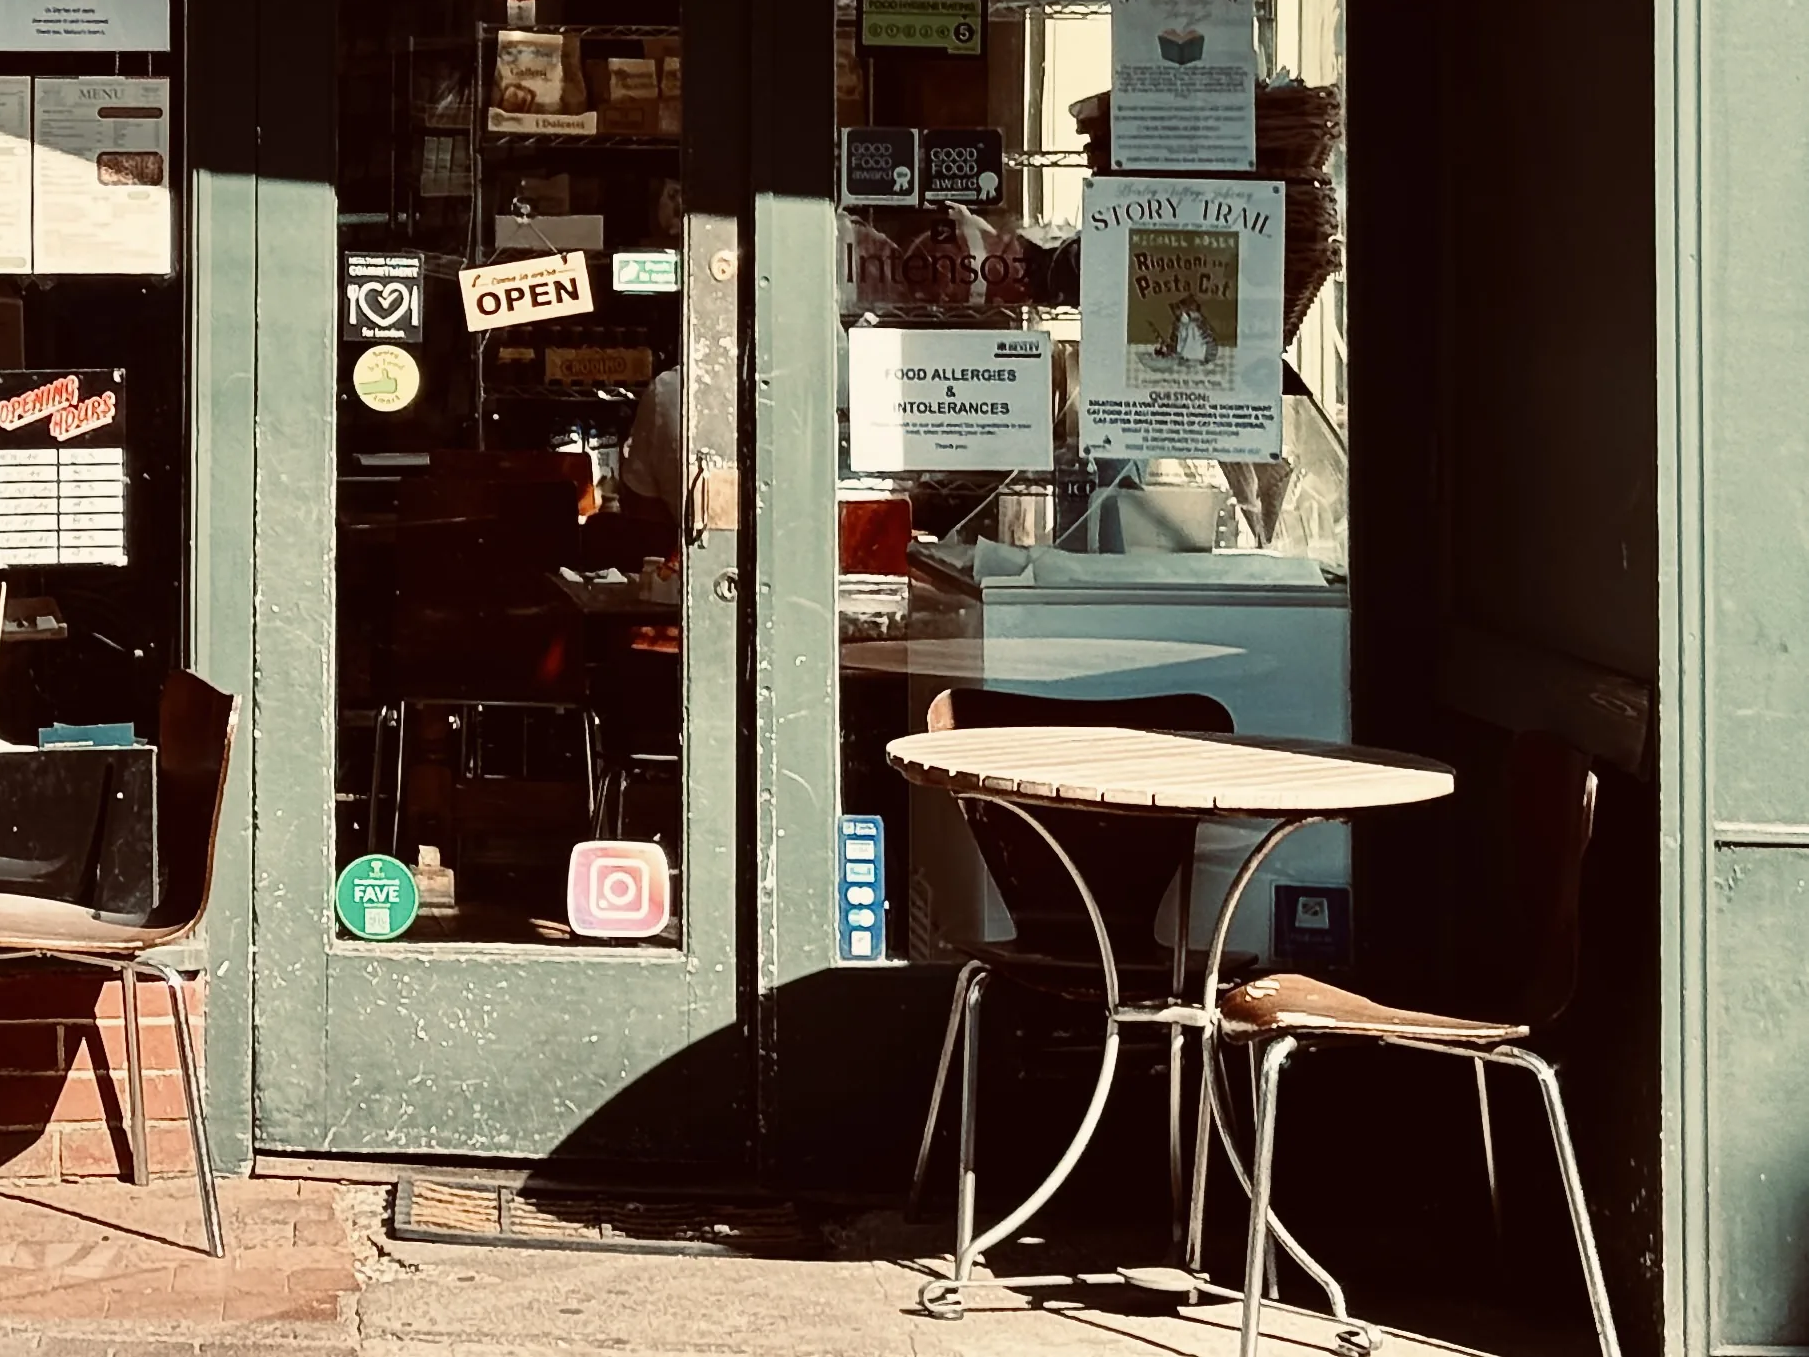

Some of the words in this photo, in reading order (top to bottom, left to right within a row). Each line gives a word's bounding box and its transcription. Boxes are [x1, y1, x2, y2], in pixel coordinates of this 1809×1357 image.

[868, 0, 897, 11] FOOD
[958, 24, 971, 41] 5
[78, 88, 125, 101] MENU
[850, 143, 893, 156] GOOD
[929, 147, 978, 162] GOOD
[851, 156, 893, 169] FOOD
[930, 161, 978, 176] FOOD
[851, 169, 892, 181] award
[930, 175, 978, 190] award
[1090, 196, 1180, 232] STORY
[1199, 196, 1272, 239] TRAIL
[1133, 250, 1208, 274] Rigatoni
[1134, 273, 1191, 300] Pasta
[1198, 272, 1232, 299] Cat
[475, 276, 581, 317] OPEN
[361, 326, 374, 338] for
[884, 367, 927, 382] FOOD
[930, 368, 1018, 383] ALLERGIES
[944, 385, 957, 398] &
[50, 392, 116, 439] HOURS
[893, 401, 1011, 416] INTOLERANCES
[353, 885, 400, 903] FAVE
